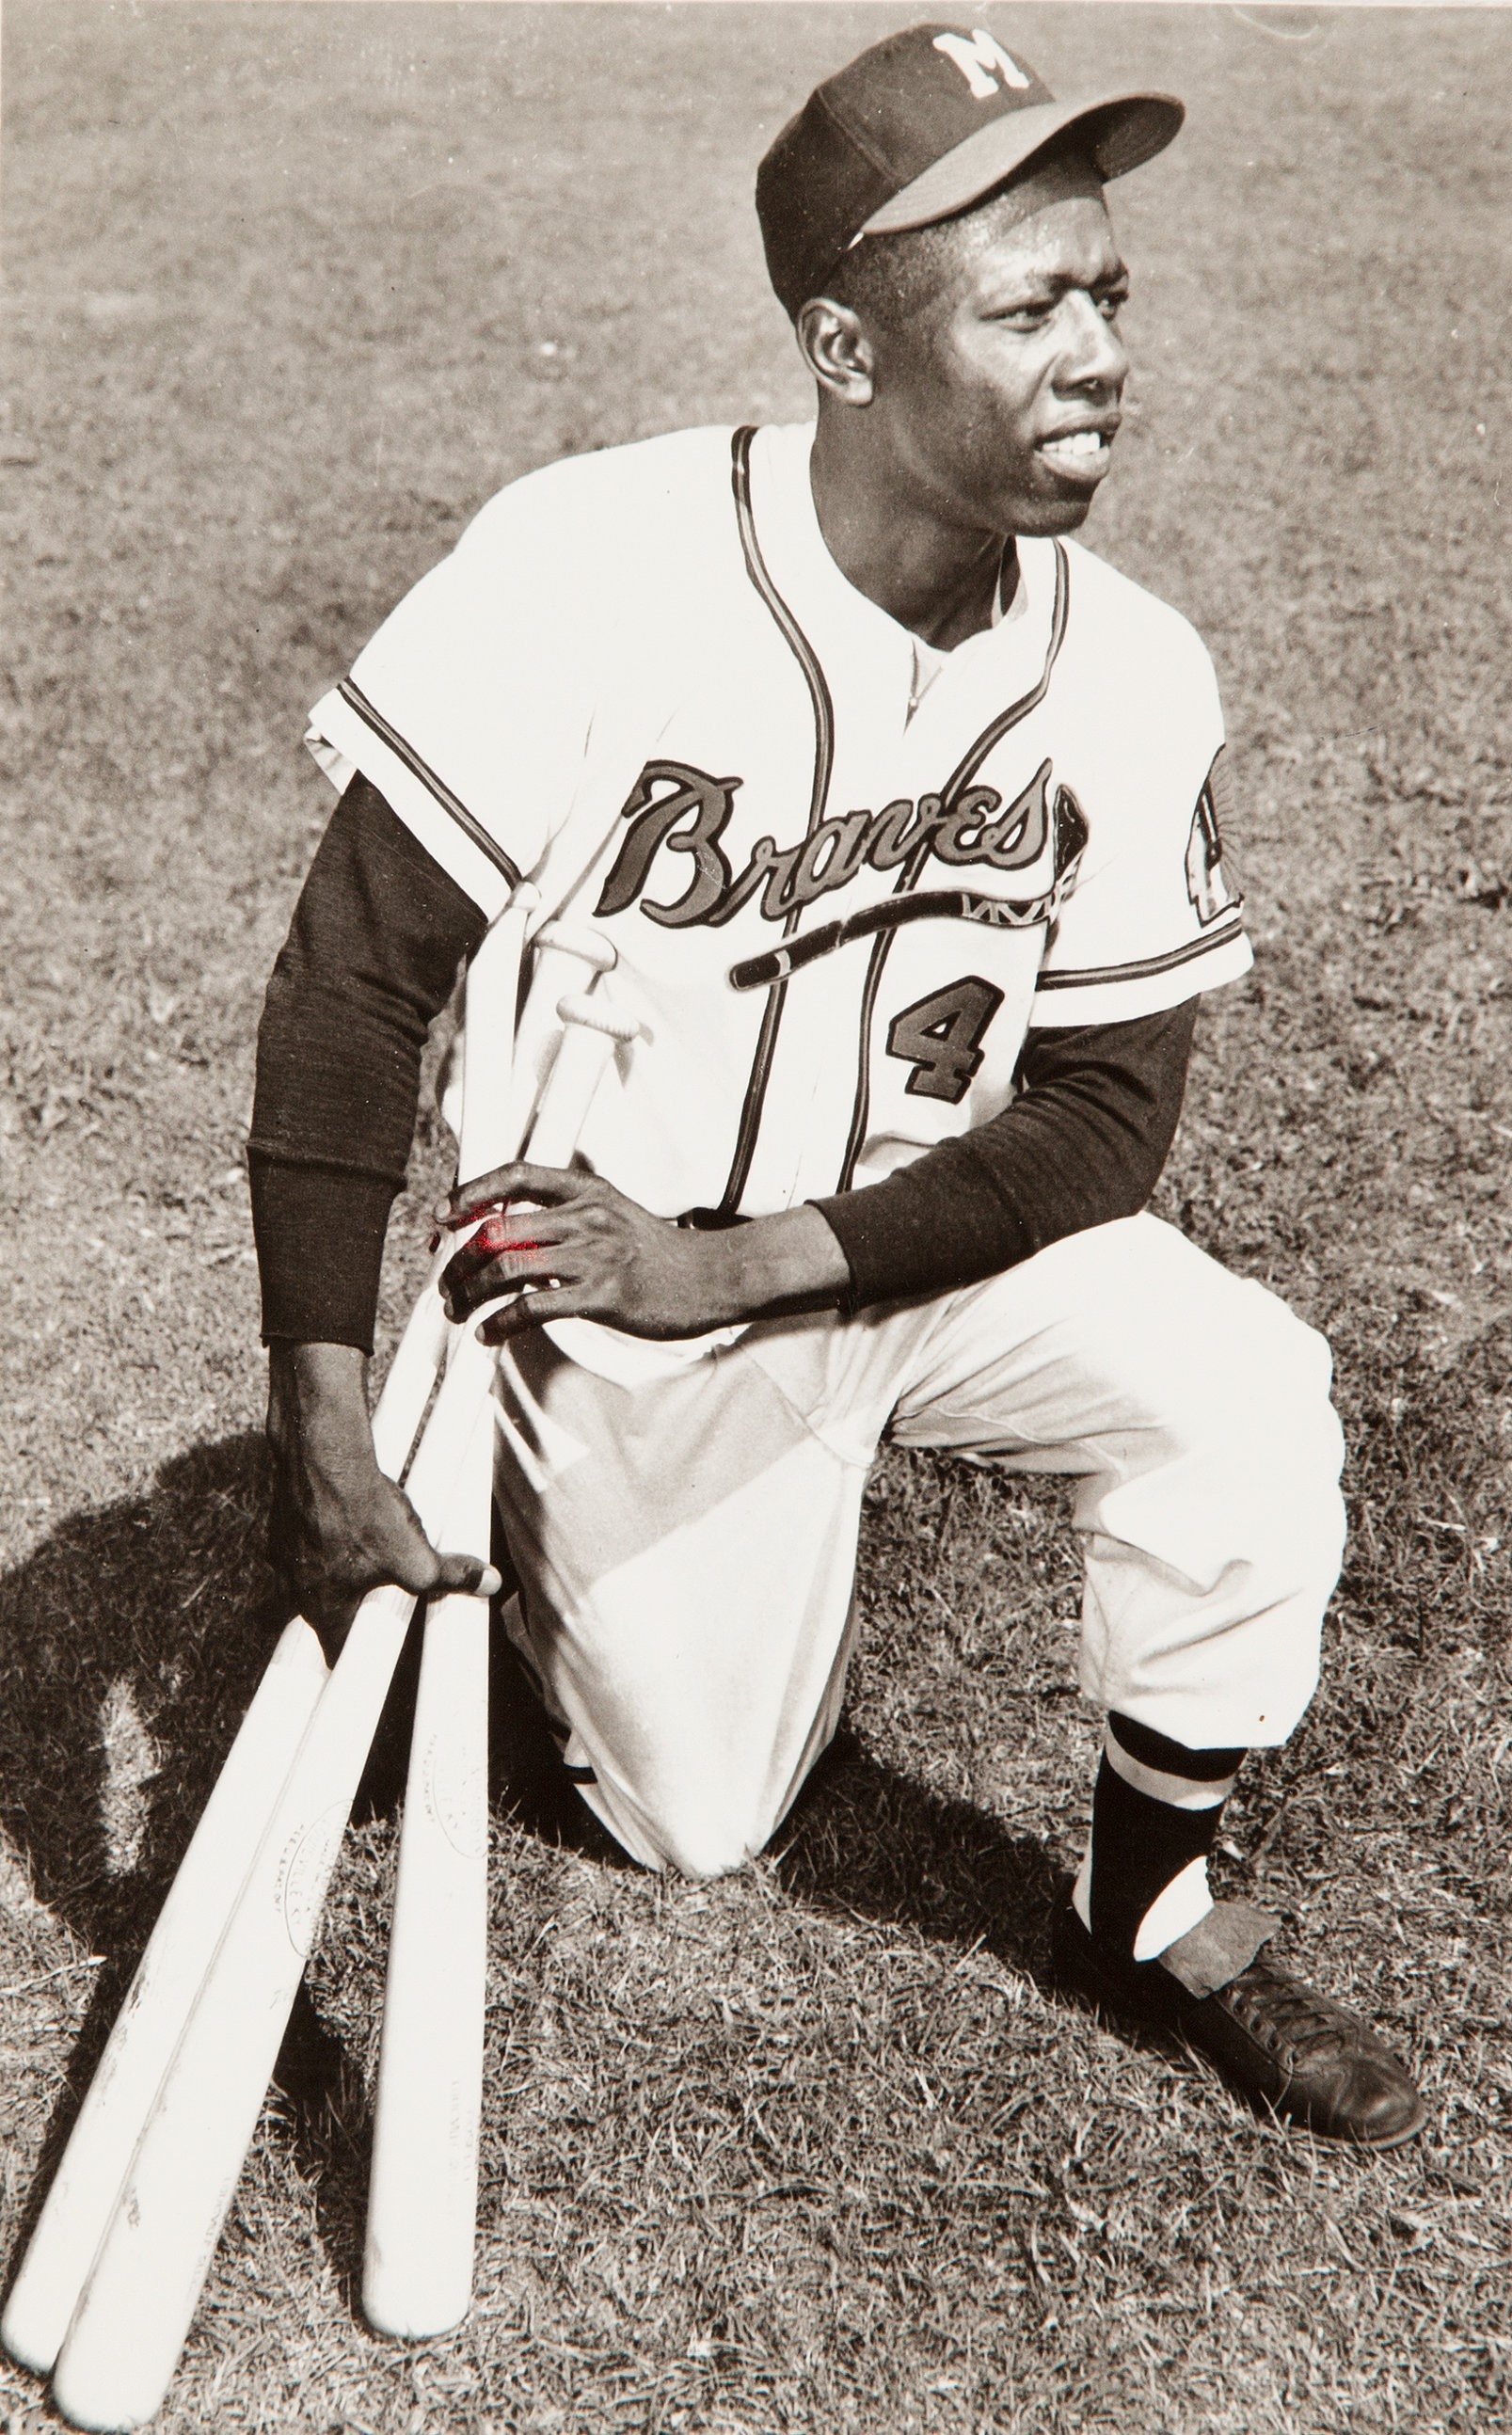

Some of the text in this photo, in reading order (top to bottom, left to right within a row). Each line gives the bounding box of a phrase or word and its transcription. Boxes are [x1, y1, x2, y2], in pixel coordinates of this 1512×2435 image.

[932, 28, 1029, 98] M
[592, 757, 1054, 928] Braves
[885, 975, 1005, 1104] 4
